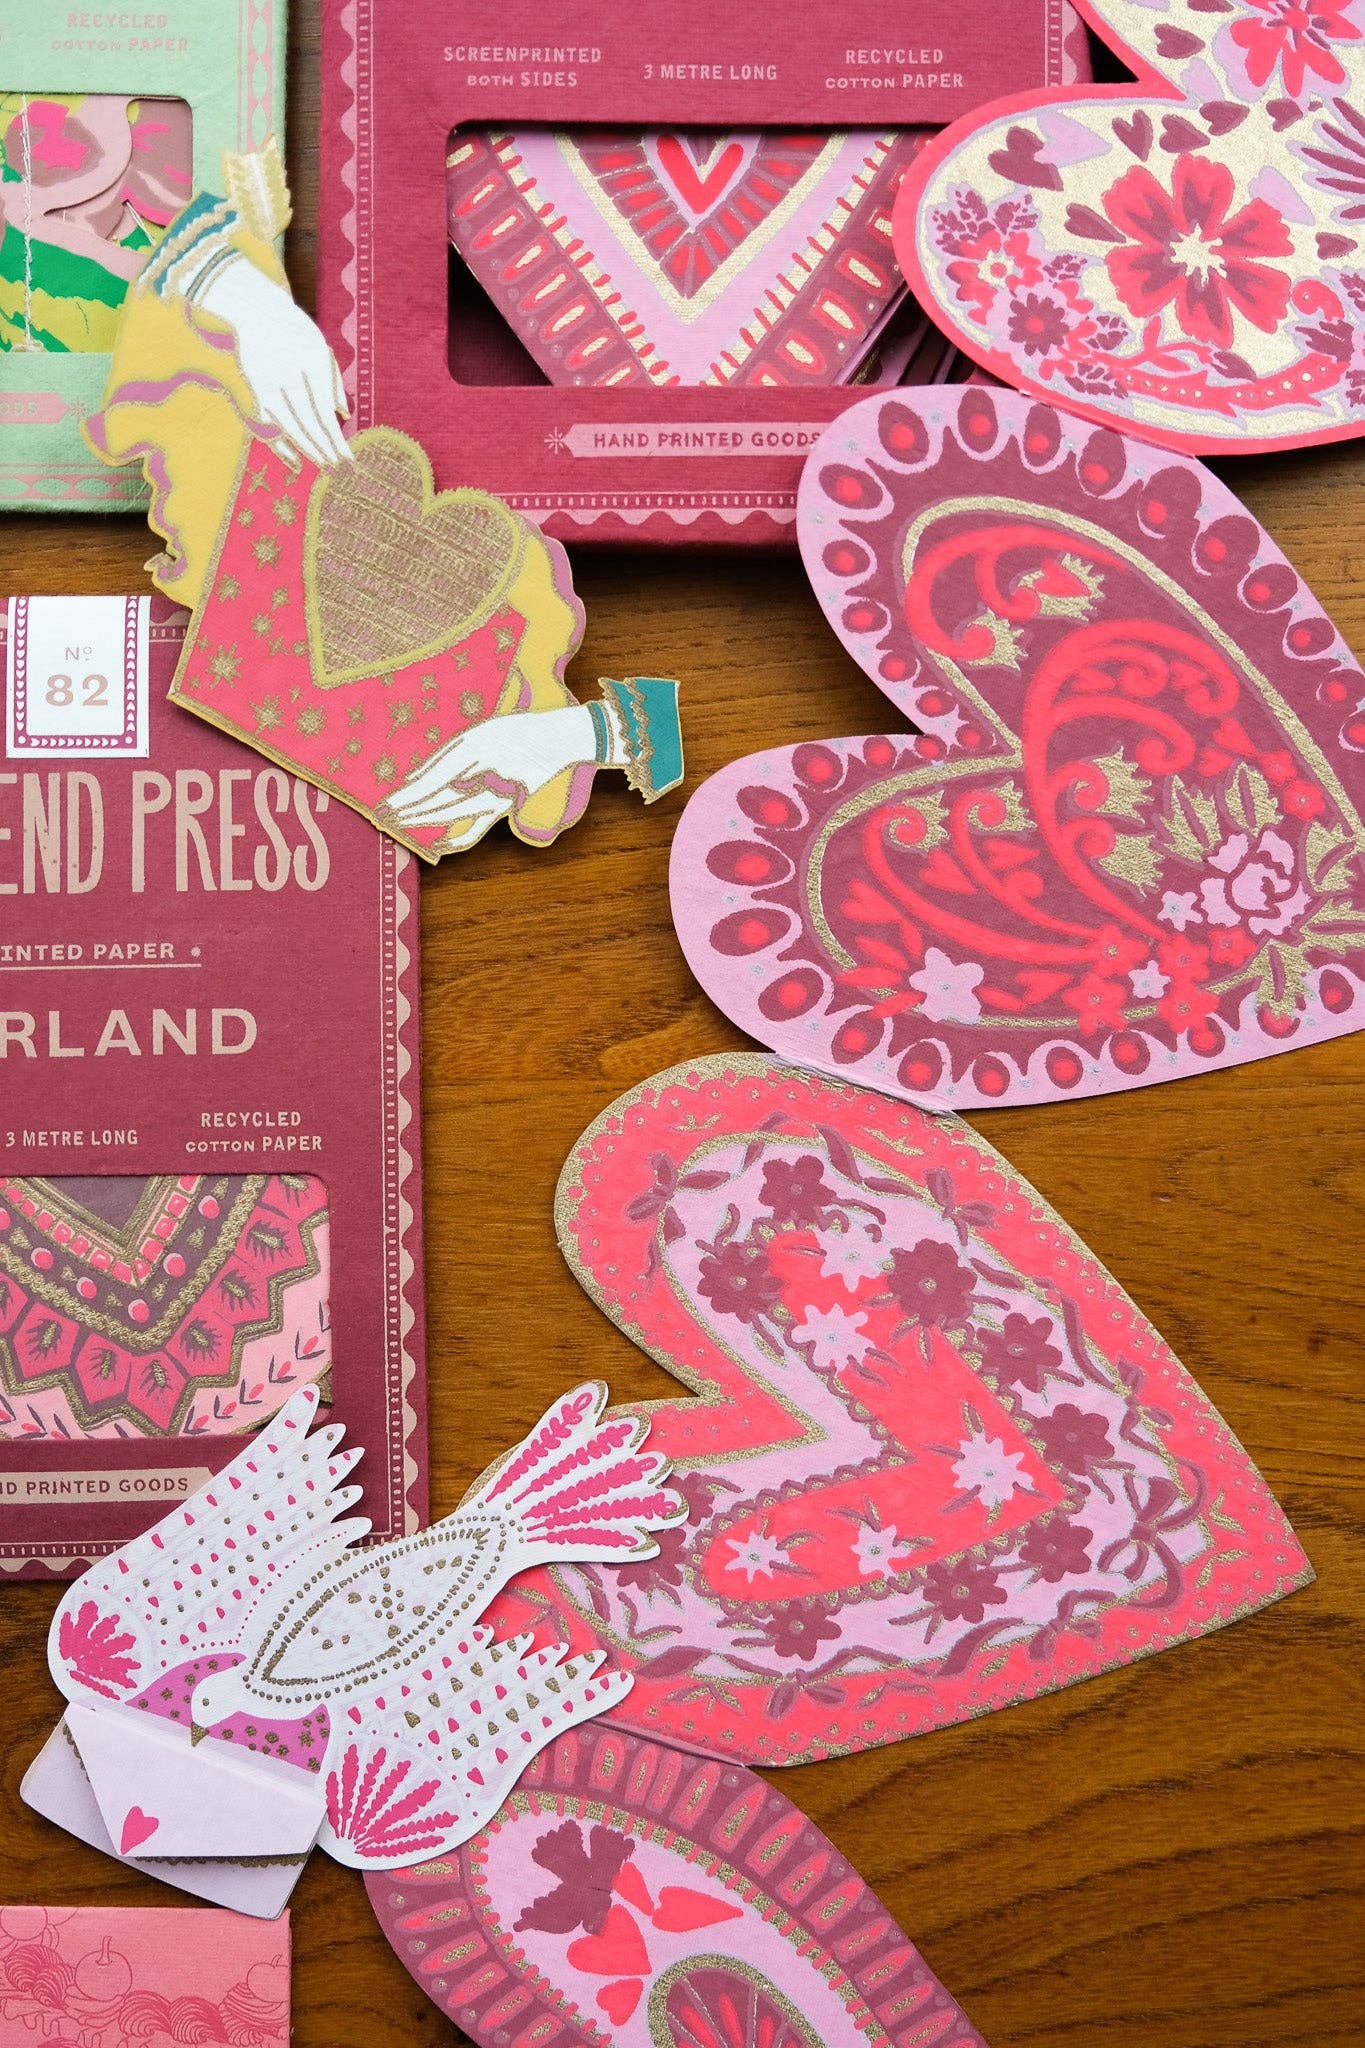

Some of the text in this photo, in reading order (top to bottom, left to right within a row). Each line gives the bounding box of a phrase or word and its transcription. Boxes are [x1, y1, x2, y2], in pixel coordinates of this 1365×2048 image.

[67, 13, 169, 29] RECYCLED
[128, 37, 189, 51] PAPER
[443, 46, 603, 64] SCREENPRINTED
[845, 48, 944, 65] RECYCLED
[466, 71, 579, 88] BOTH SIDES
[643, 63, 778, 81] 3 METRE LONG
[824, 73, 965, 89] COTTON PAPER
[593, 432, 650, 449] HAND
[657, 431, 744, 448] PRINTED
[45, 674, 109, 708] 82
[132, 768, 331, 894] PRESS
[93, 942, 176, 961] PAPER
[0, 1008, 258, 1059] RLAND
[201, 1111, 302, 1129] RECYCLED
[5, 1129, 139, 1148] 3 METRE LONG
[185, 1135, 323, 1153] COTTON PAPER
[26, 1479, 111, 1496] PRINTED
[119, 1476, 189, 1493] GOODS
